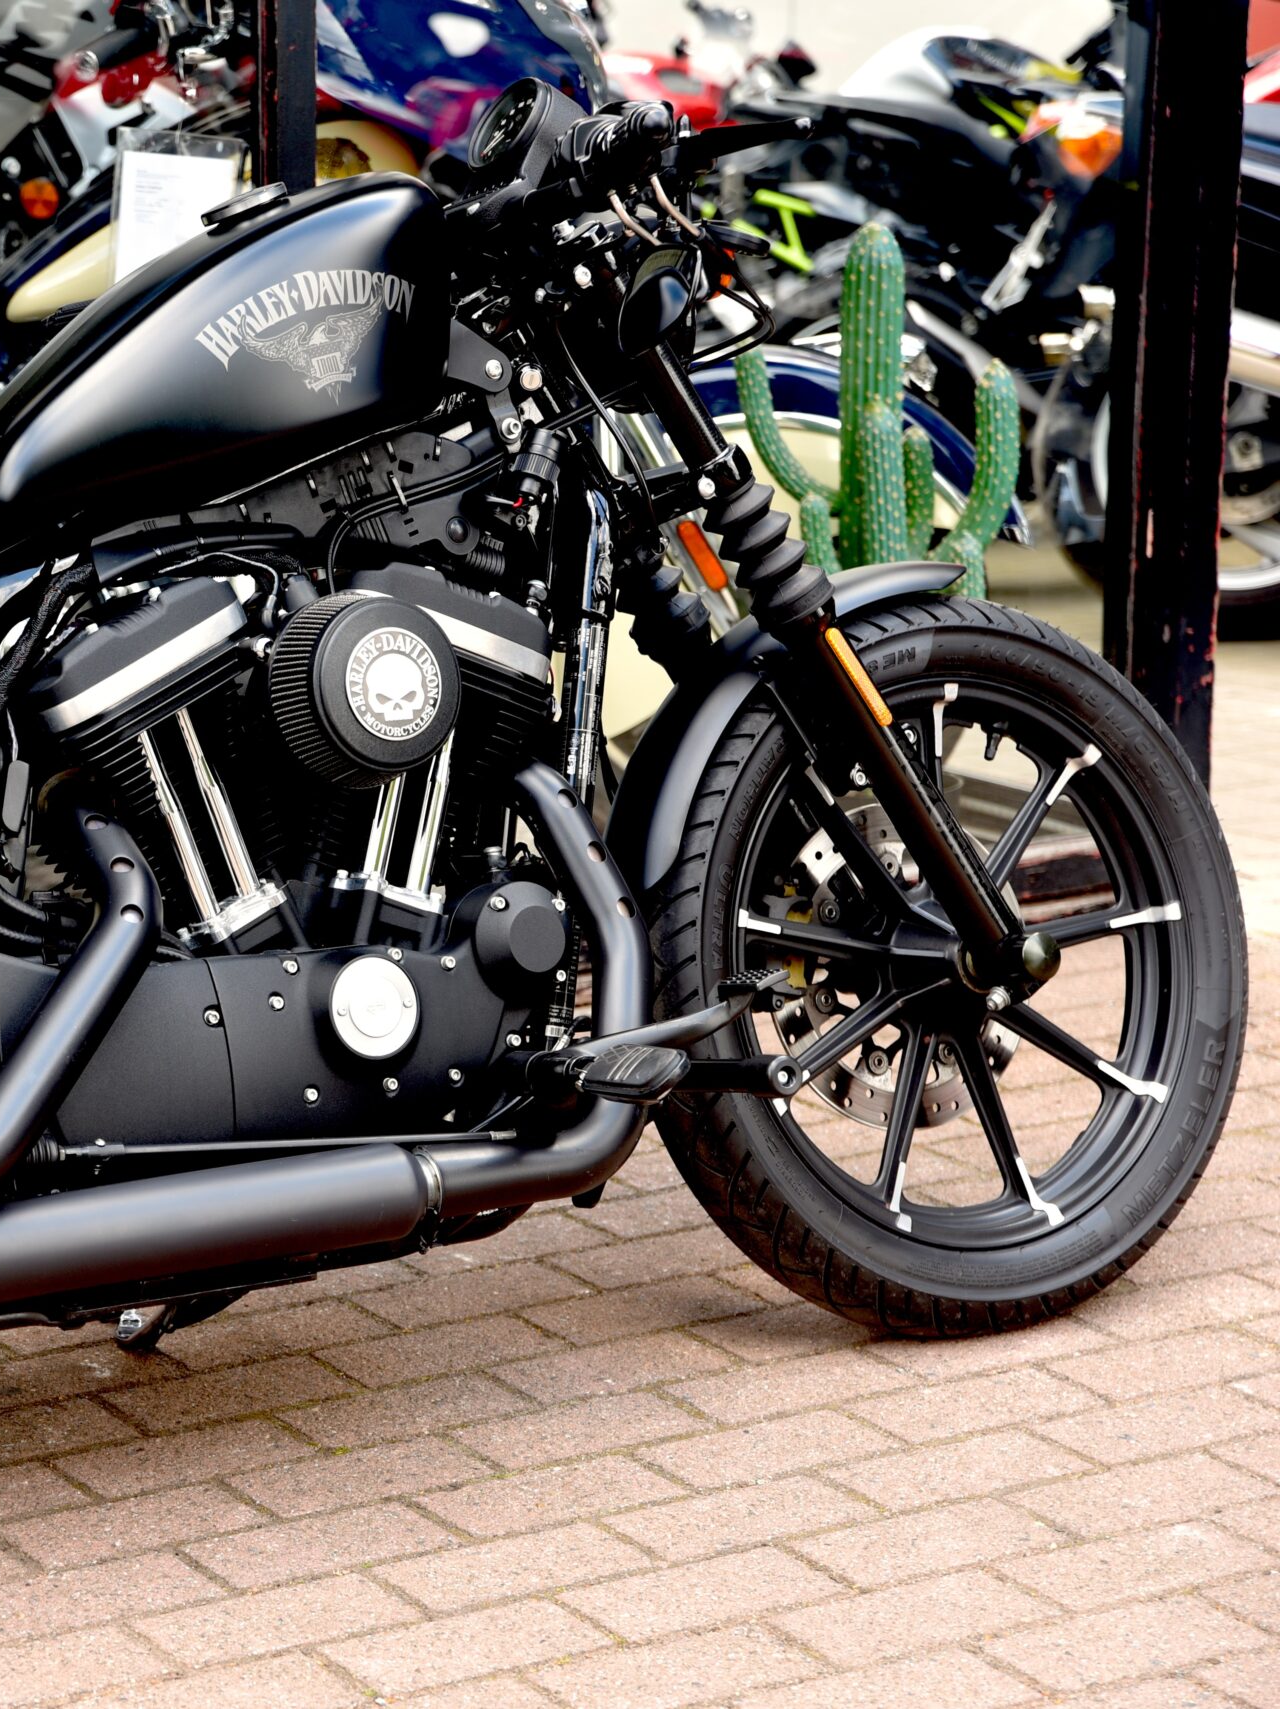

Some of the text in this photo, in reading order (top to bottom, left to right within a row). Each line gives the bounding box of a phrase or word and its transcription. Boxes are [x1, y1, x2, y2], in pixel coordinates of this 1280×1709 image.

[349, 633, 440, 707] HARLEY-DAVIDSON
[362, 705, 436, 737] MOTORCYCLES
[1121, 1037, 1227, 1228] METZELER
